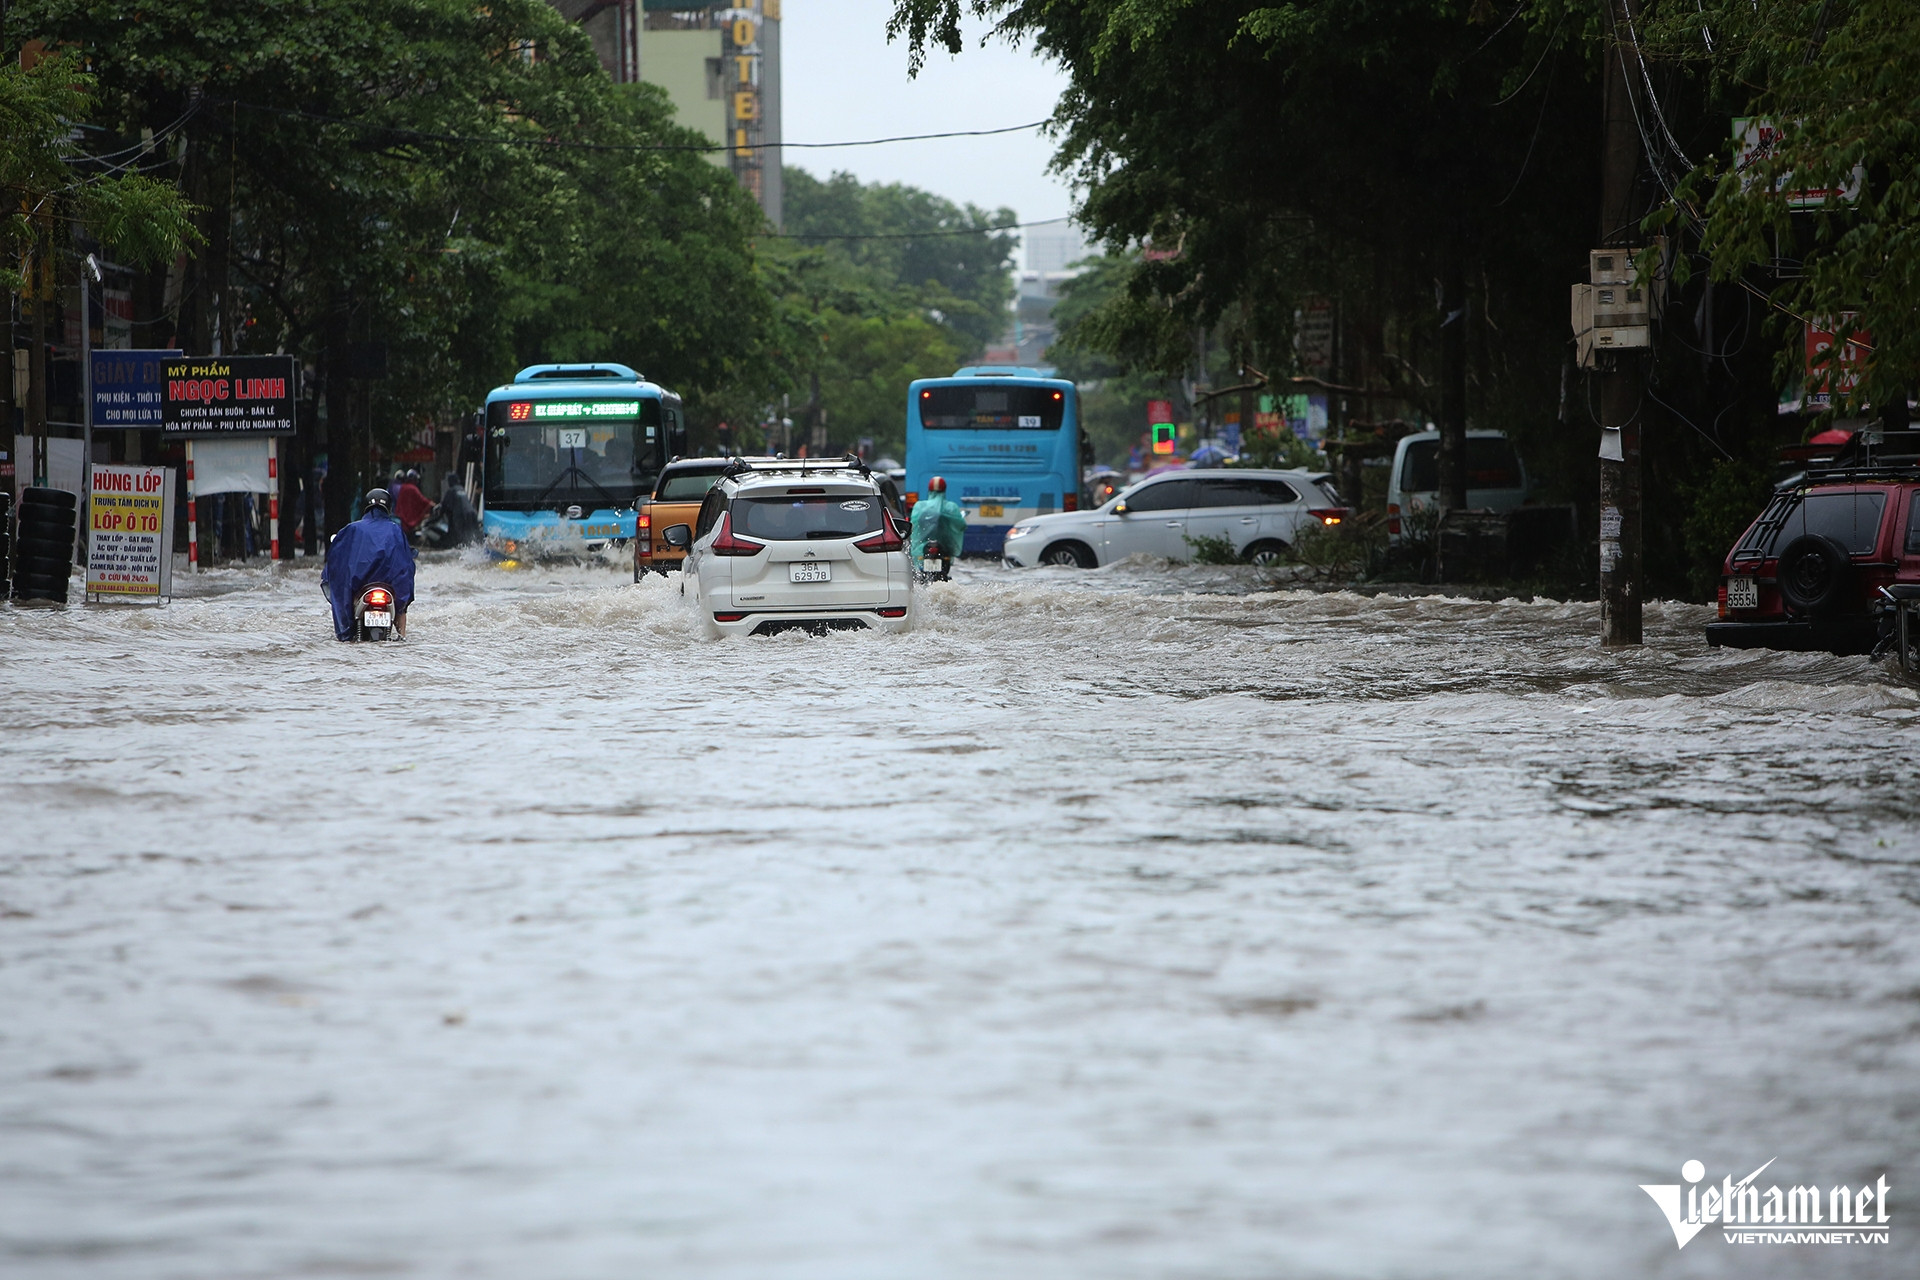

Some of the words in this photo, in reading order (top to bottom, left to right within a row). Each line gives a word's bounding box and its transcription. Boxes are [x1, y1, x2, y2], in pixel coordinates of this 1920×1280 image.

[168, 365, 187, 377] MỸ
[192, 361, 230, 376] PHẨM
[96, 392, 111, 404] PHỤ
[113, 391, 130, 404] KIỆN
[168, 379, 229, 405] NGỌC
[235, 378, 285, 399] LINH
[106, 409, 120, 420] CHO
[122, 410, 136, 422] MỌI
[180, 407, 207, 417] CHUYÊN
[209, 406, 223, 416] BÁN
[225, 406, 244, 416] BUÔN
[251, 406, 265, 416] BÁN
[510, 403, 531, 419] 37
[182, 420, 191, 430] MỸ
[193, 418, 212, 430] PHẨM
[220, 420, 234, 430] PHỤ
[236, 420, 250, 430] LIỆU
[252, 420, 276, 429] NGÀNH
[278, 419, 290, 428] TÓC
[566, 433, 580, 444] 37
[93, 469, 132, 492] HÙNG
[136, 466, 162, 492] LỐP
[94, 497, 116, 506] TRUNG
[118, 497, 132, 508] TÂM
[134, 499, 149, 509] DỊCH
[150, 500, 159, 510] VỤ
[94, 509, 122, 530] LỐP
[126, 512, 136, 530] Ô
[141, 513, 158, 532] TÔ
[96, 534, 110, 542] THAY
[116, 564, 126, 572] 360
[801, 562, 818, 571] 36A
[794, 572, 827, 580] 629.78
[1734, 579, 1750, 592] 30A
[1728, 593, 1756, 606] 555.54
